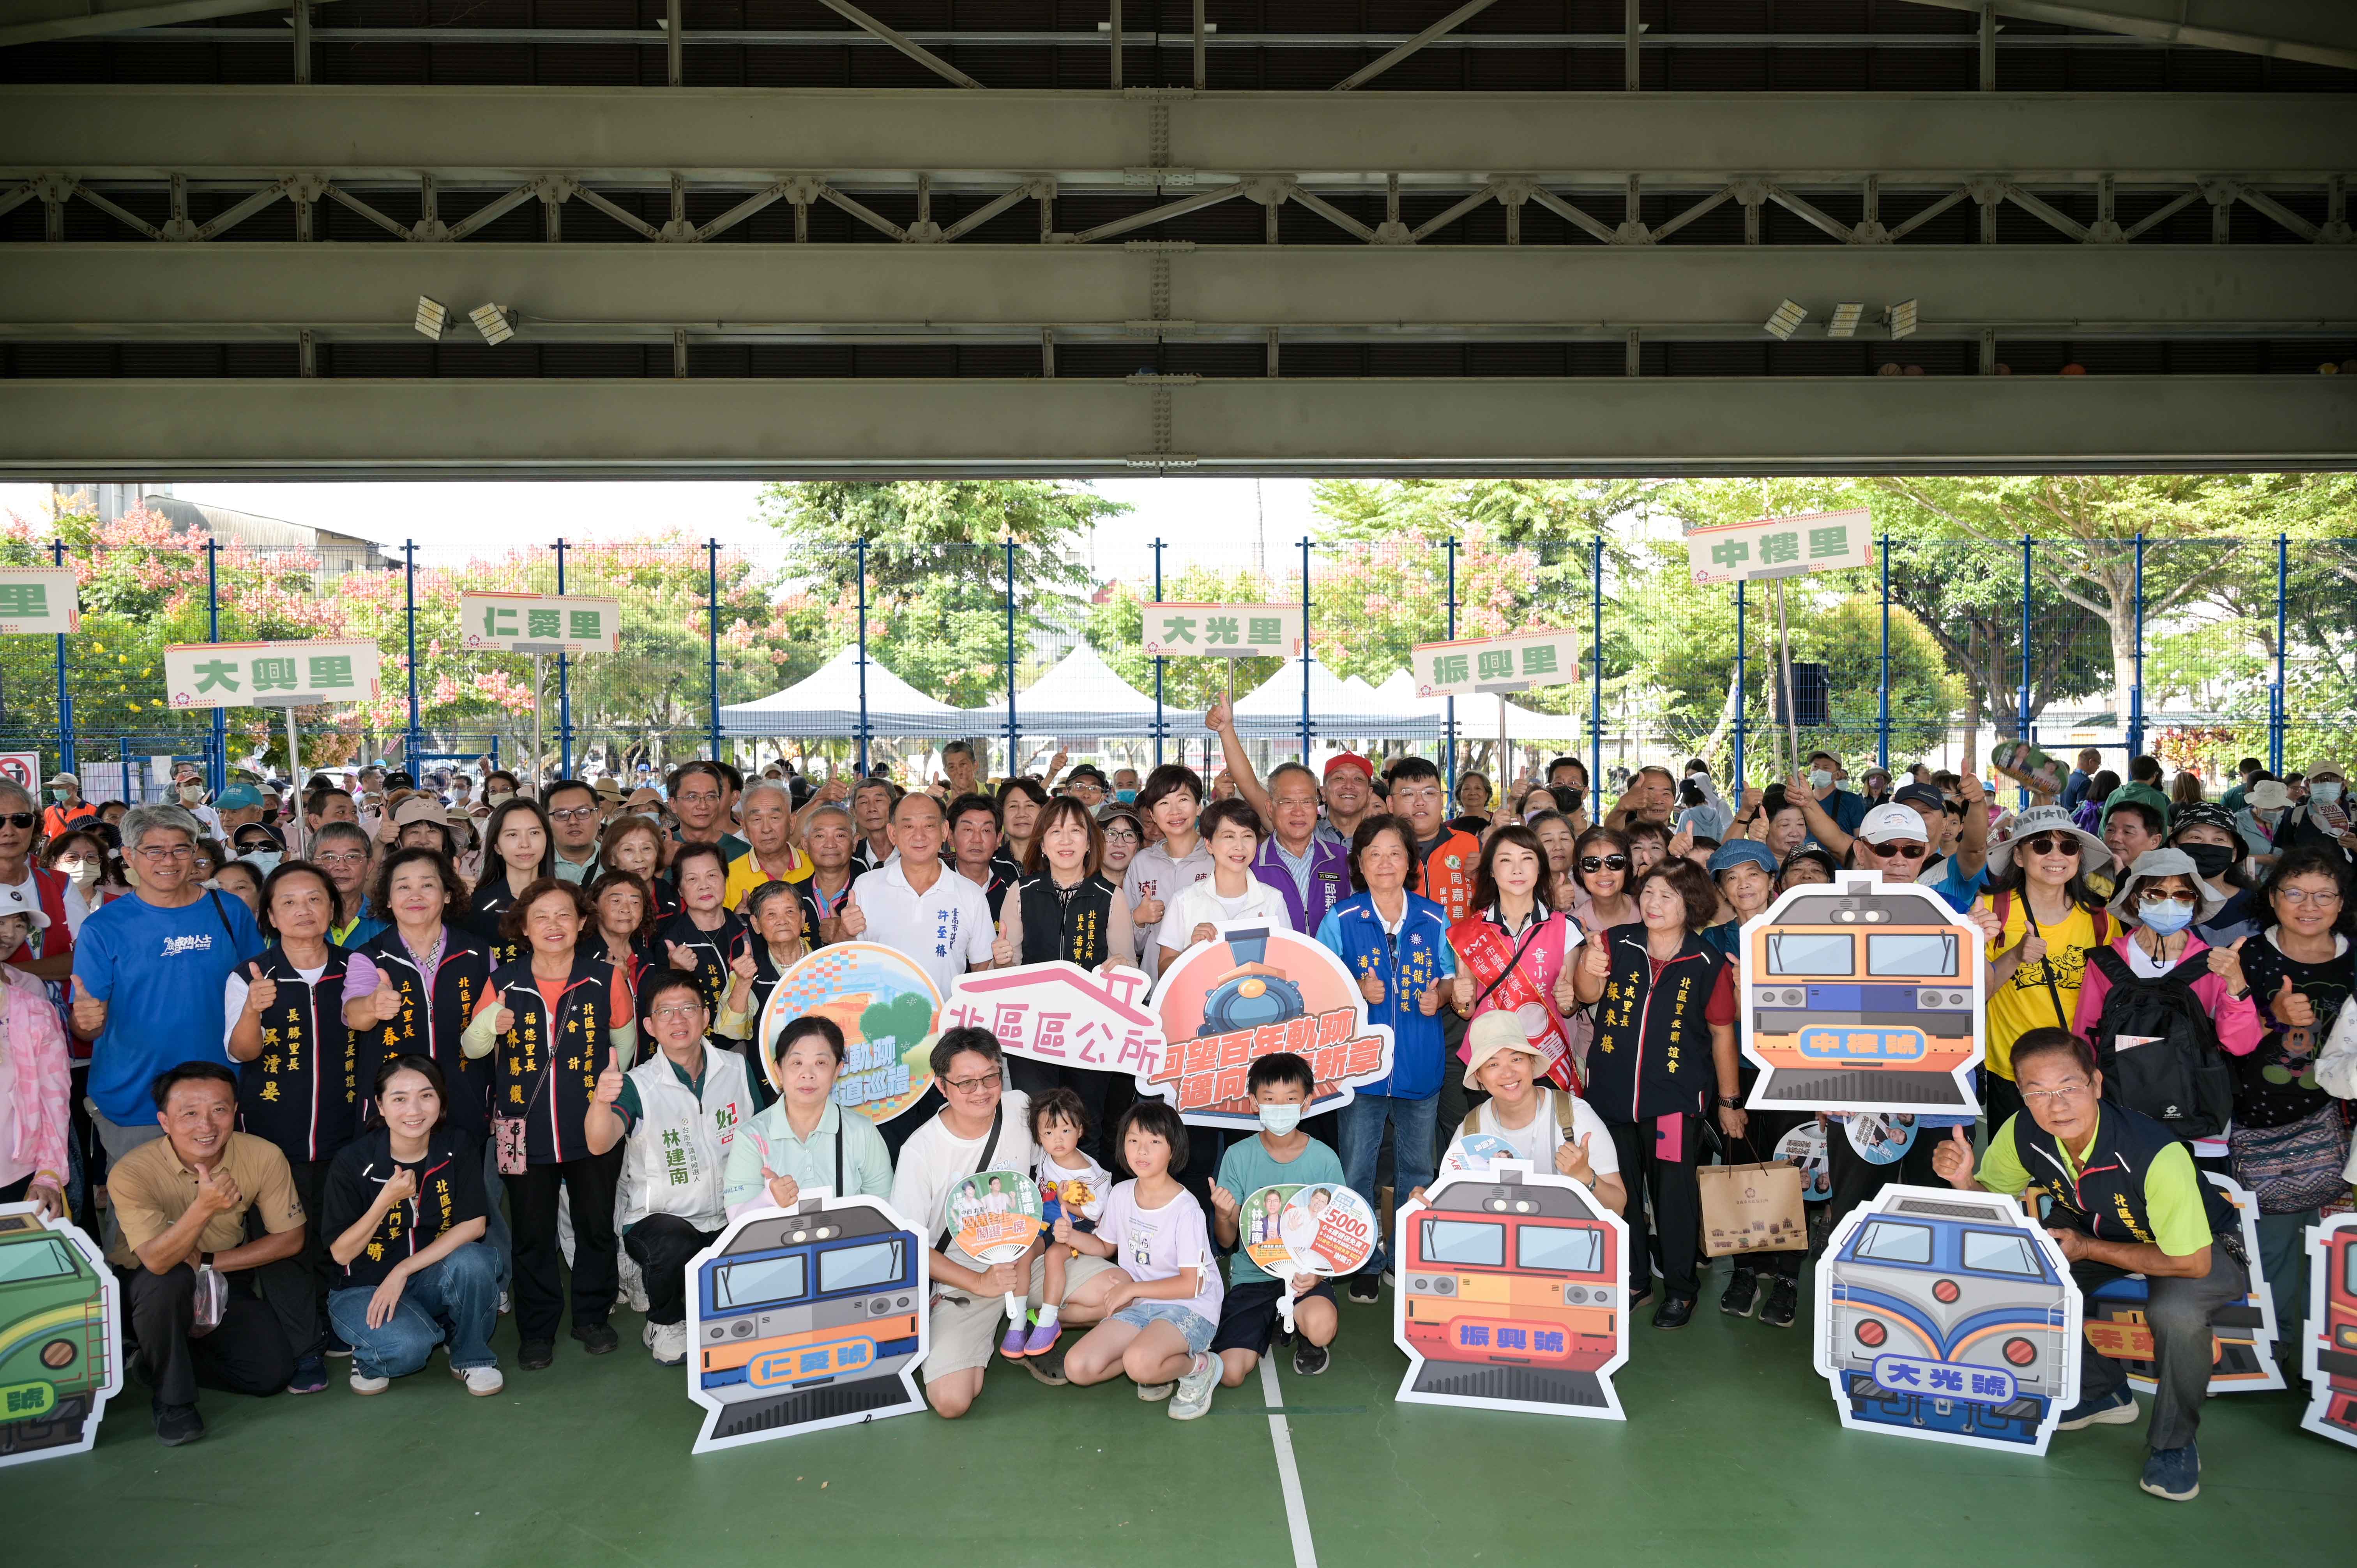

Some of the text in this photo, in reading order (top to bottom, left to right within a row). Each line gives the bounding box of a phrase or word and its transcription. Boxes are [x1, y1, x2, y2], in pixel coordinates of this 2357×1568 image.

[1711, 525, 1849, 568] 中樓里
[484, 606, 601, 639] 仁愛里
[1163, 616, 1282, 645] 大光里
[194, 655, 354, 694] 大興里
[1433, 645, 1559, 685] 振興里
[2320, 805, 2337, 813] 5000
[1451, 872, 1464, 919] 周嘉韋
[174, 934, 212, 946] 成功人士
[935, 909, 949, 958] 許至椿
[949, 908, 960, 950] 臺南市議員
[1076, 913, 1085, 931] 區長
[1085, 910, 1097, 961] 北區區公所
[1371, 947, 1381, 966] 秘書
[1412, 951, 1425, 1002] 謝龍介
[400, 980, 415, 1038] 立人里長
[1400, 964, 1412, 1012] 服務團隊
[1619, 971, 1640, 1027] 文成里長
[286, 1008, 302, 1071] 長勝里長
[458, 977, 471, 1072] 北區里長會
[524, 1012, 538, 1072] 福德里長
[566, 1021, 580, 1070] 會計
[945, 1003, 1162, 1075] 北區區公所
[1151, 1008, 1354, 1081] 回望百年軌跡
[1666, 977, 1692, 1074] 北區里長聯誼會
[1809, 1033, 1917, 1055] 中樓號
[583, 1003, 596, 1104] 北區里長聯誼會
[1179, 1037, 1382, 1111] 邁向新章
[662, 1128, 689, 1186] 林建南
[682, 1126, 701, 1183] 台南市議員候選人
[1018, 1180, 1035, 1215] 林建南
[976, 1219, 1026, 1241] 關鍵一席
[1251, 1208, 1263, 1244] 林建南
[1325, 1208, 1368, 1237] 5000
[1460, 1324, 1564, 1353] 振興號
[760, 1344, 867, 1380] 仁愛號
[1887, 1363, 2006, 1397] 大光號
[7, 1386, 44, 1413] 號
